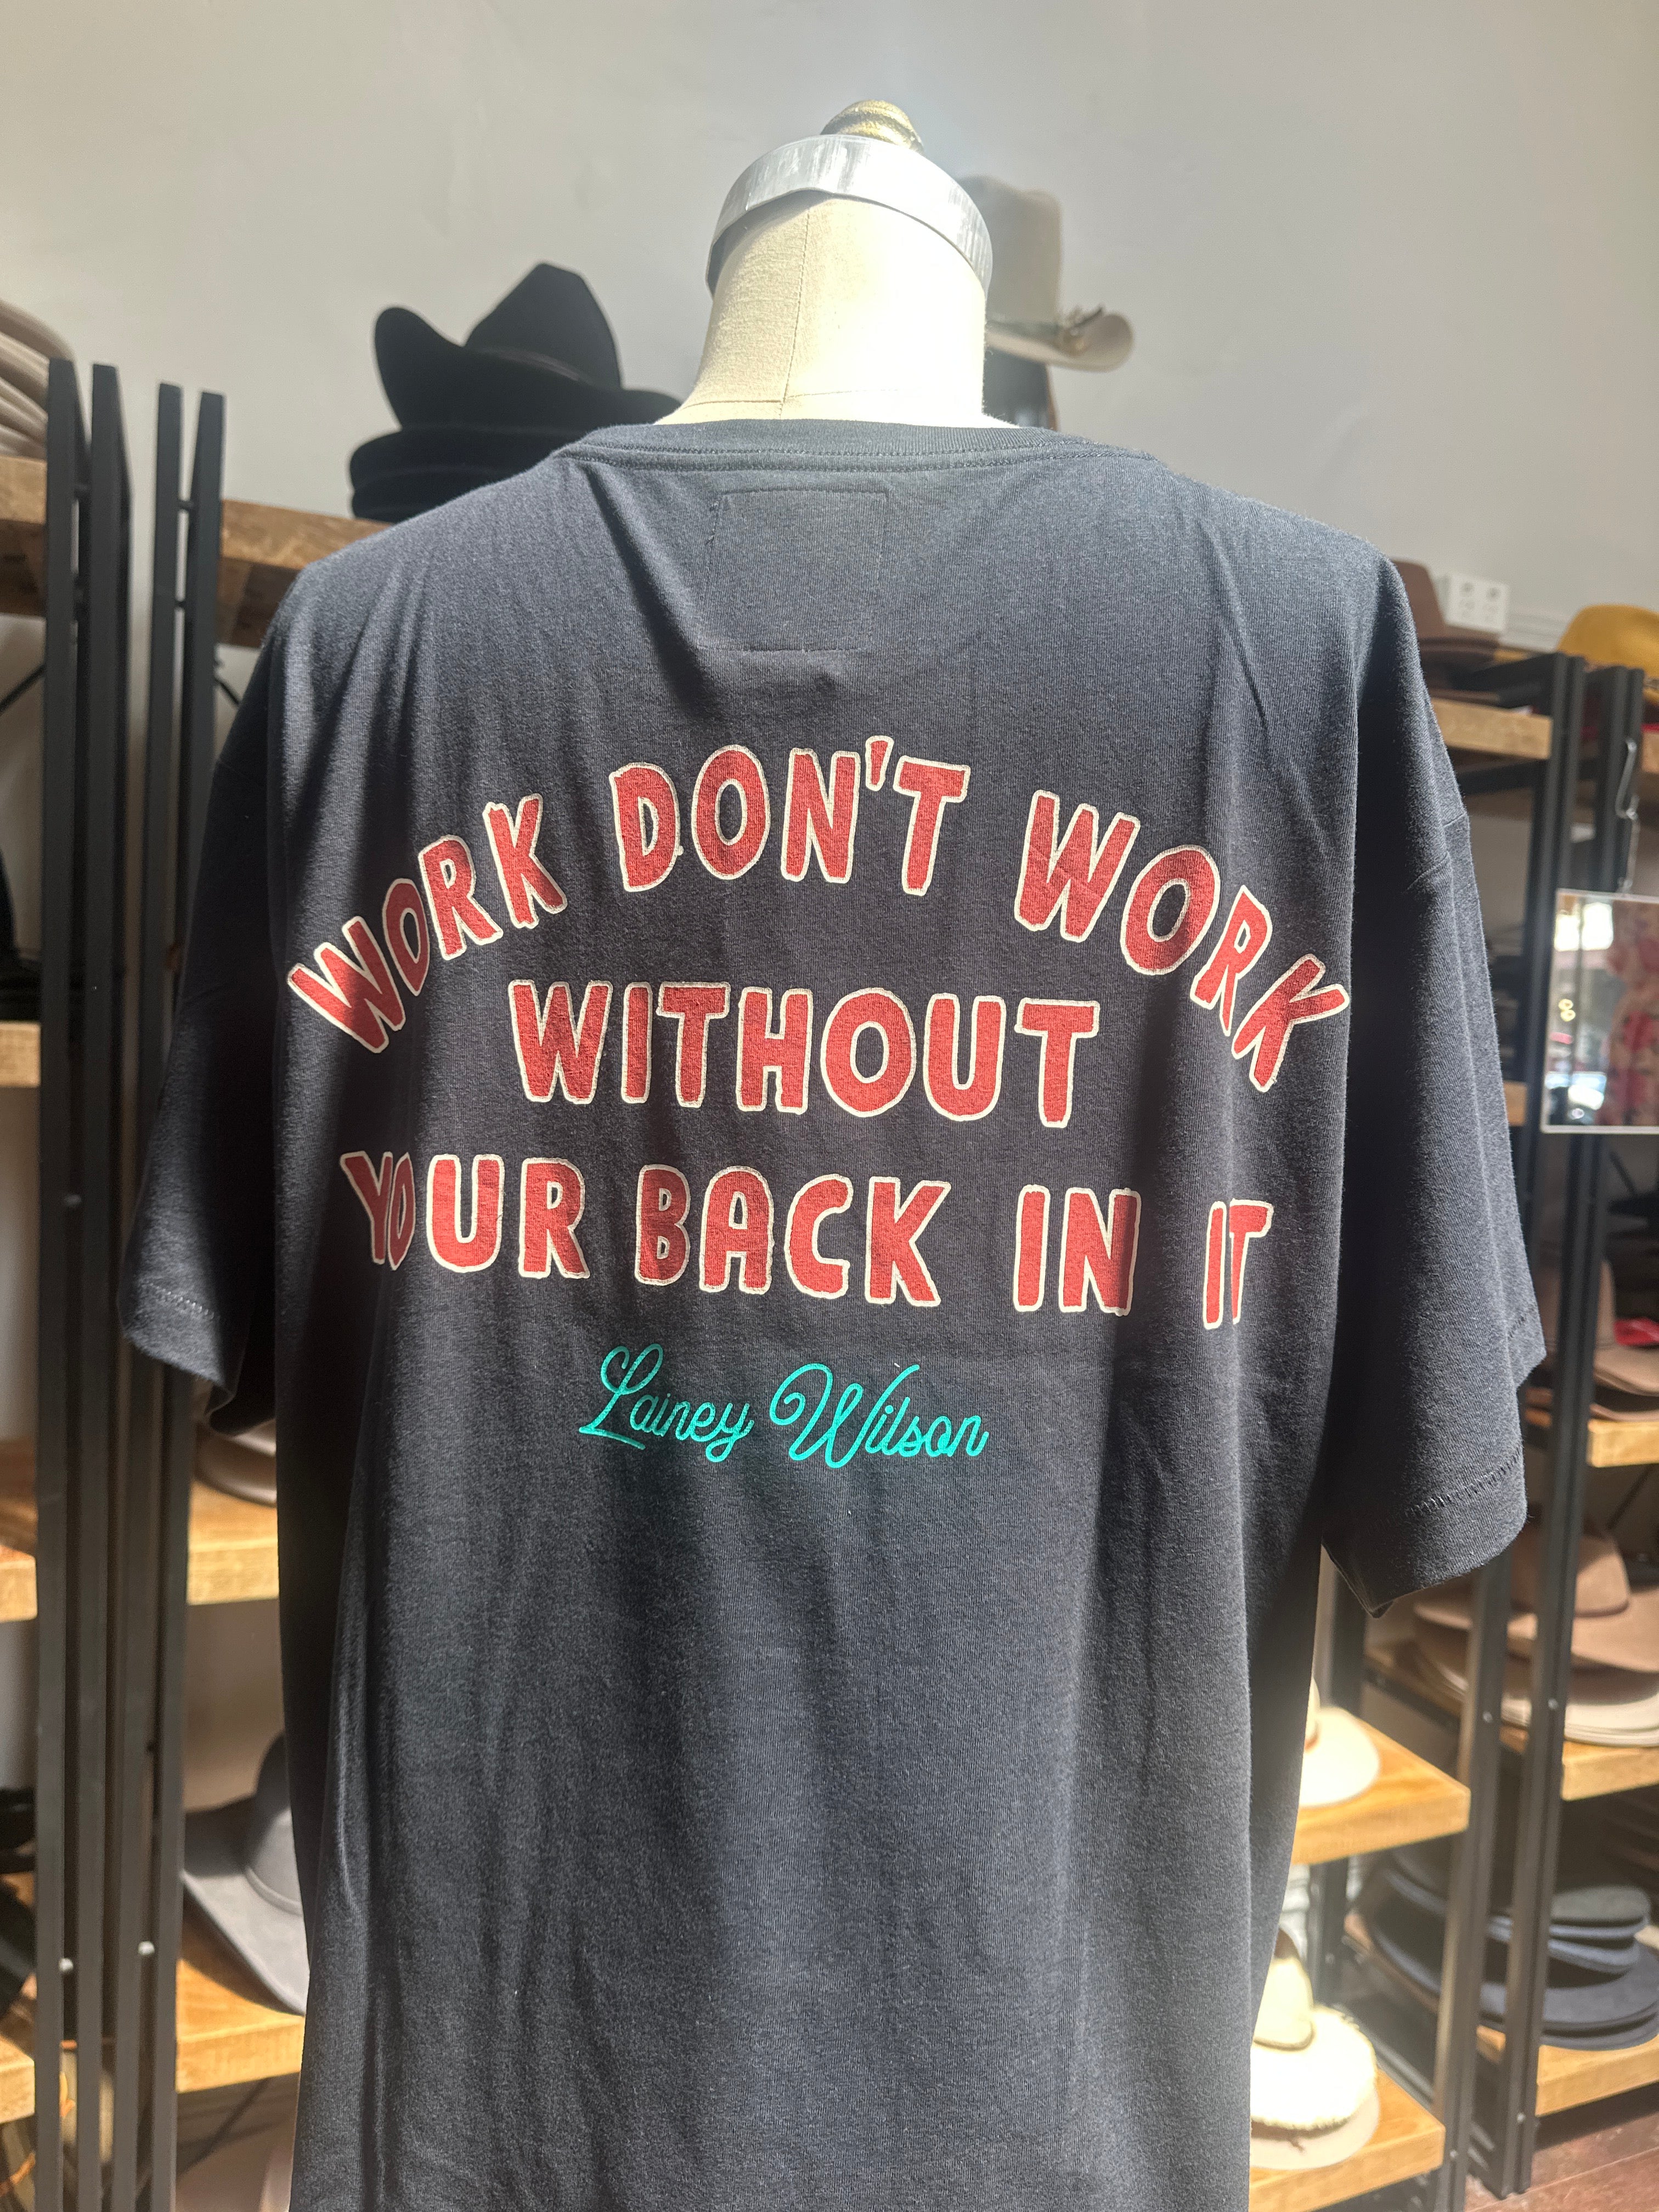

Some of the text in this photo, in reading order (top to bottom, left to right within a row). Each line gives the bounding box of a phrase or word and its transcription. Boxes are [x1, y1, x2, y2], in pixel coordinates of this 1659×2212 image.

[287, 735, 1350, 1092] WORK DON'T WORK
[508, 979, 1100, 1128] WITHOUT
[340, 1151, 1274, 1330] YOUR BACK IN IT
[578, 1344, 990, 1470] Lainey Wilson
